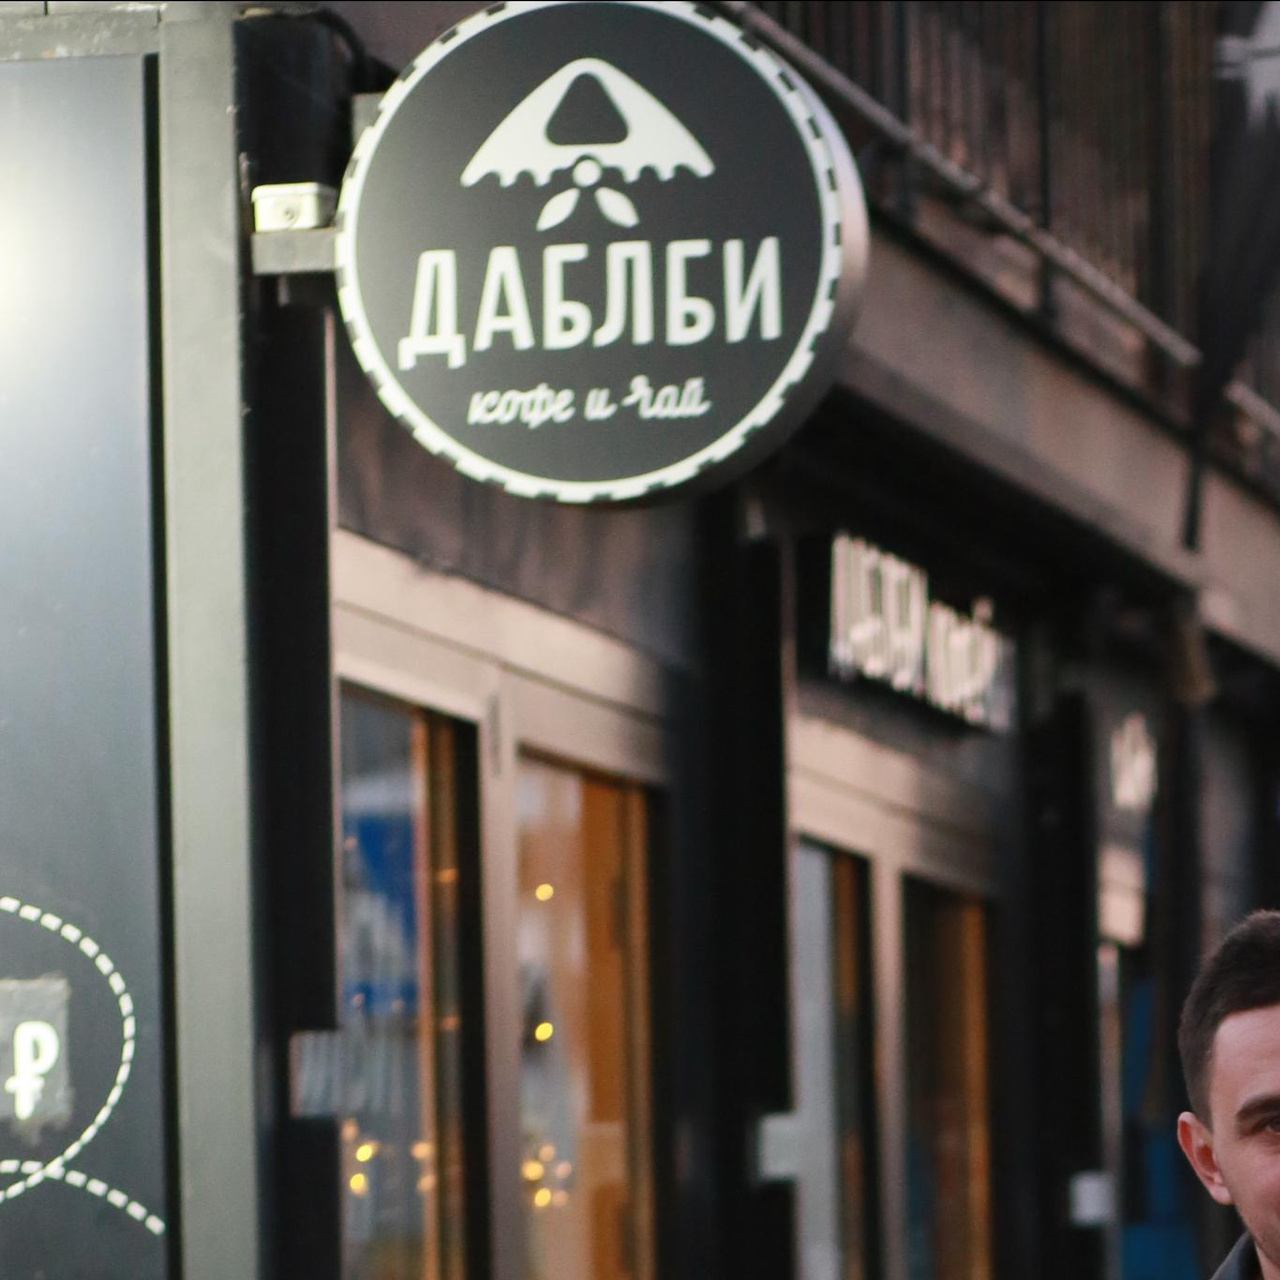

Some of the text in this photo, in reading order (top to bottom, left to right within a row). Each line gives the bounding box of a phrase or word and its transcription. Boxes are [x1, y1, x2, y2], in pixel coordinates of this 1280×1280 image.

[397, 236, 784, 371] ДАБЛБИ
[467, 374, 712, 429] кофе и чай
